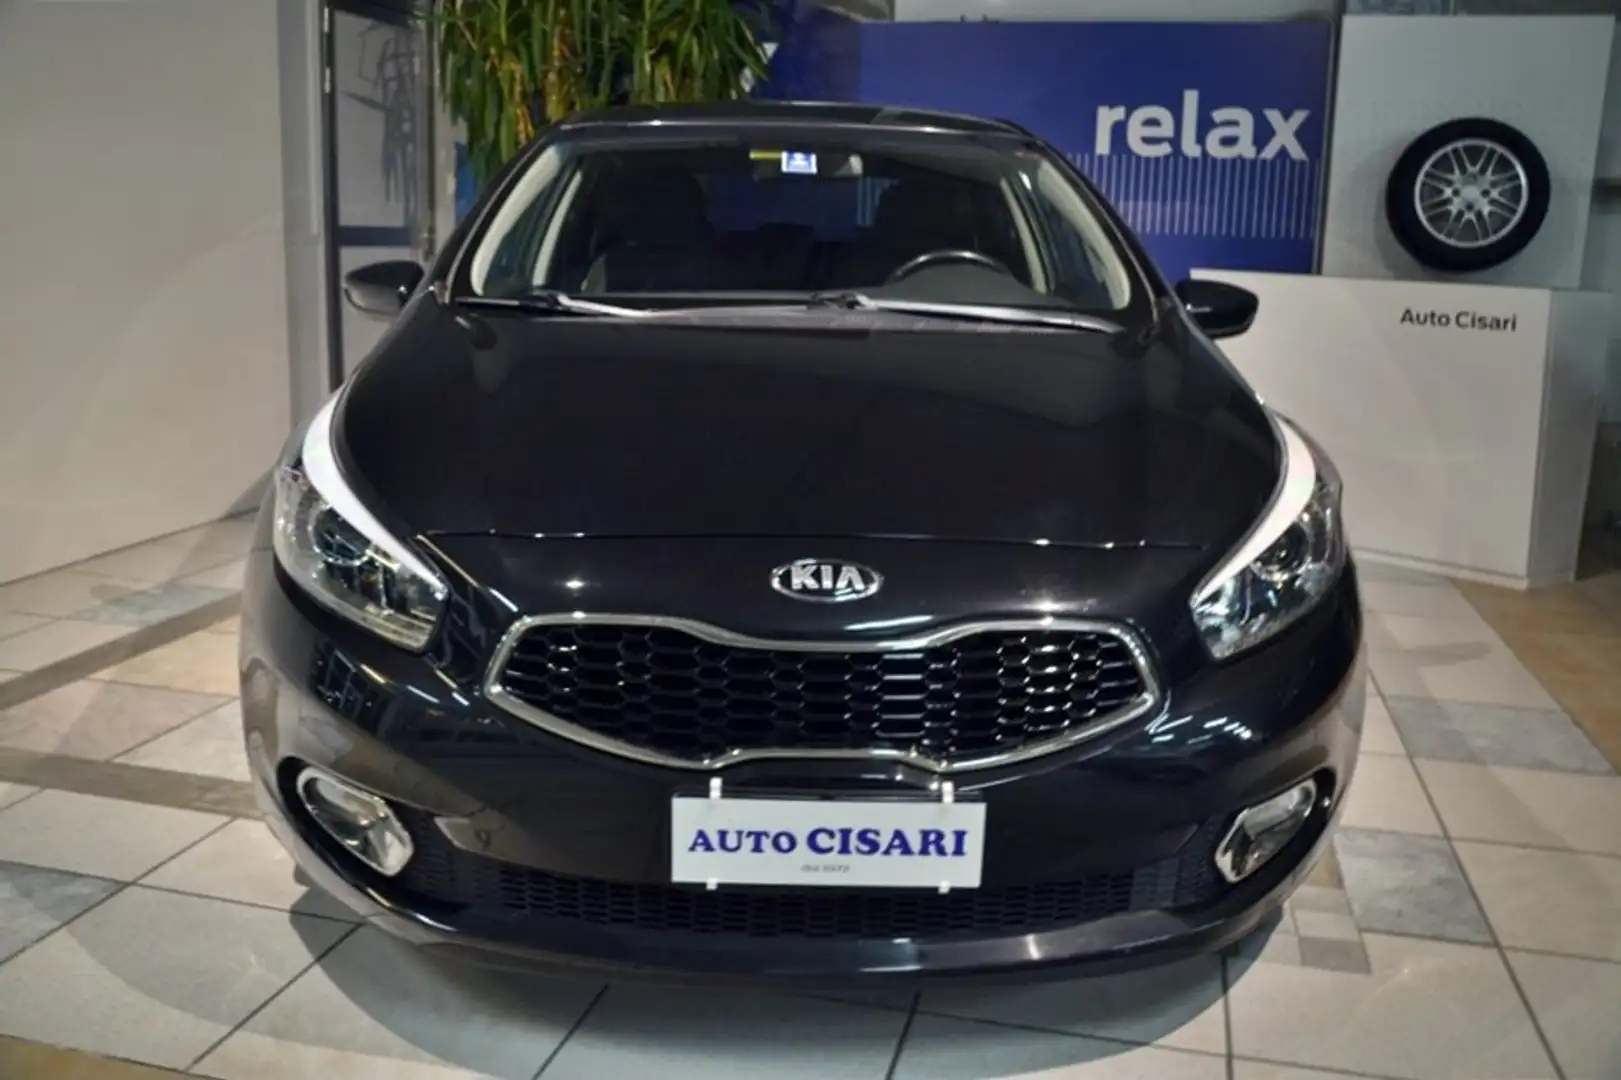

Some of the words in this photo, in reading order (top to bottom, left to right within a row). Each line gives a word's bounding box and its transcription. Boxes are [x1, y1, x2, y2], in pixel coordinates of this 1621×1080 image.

[1095, 89, 1310, 161] relax
[1400, 308, 1451, 328] Auto
[1455, 310, 1517, 332] Cisari
[791, 564, 865, 590] KIA
[688, 829, 798, 854] AUTO
[806, 828, 968, 856] CISARI
